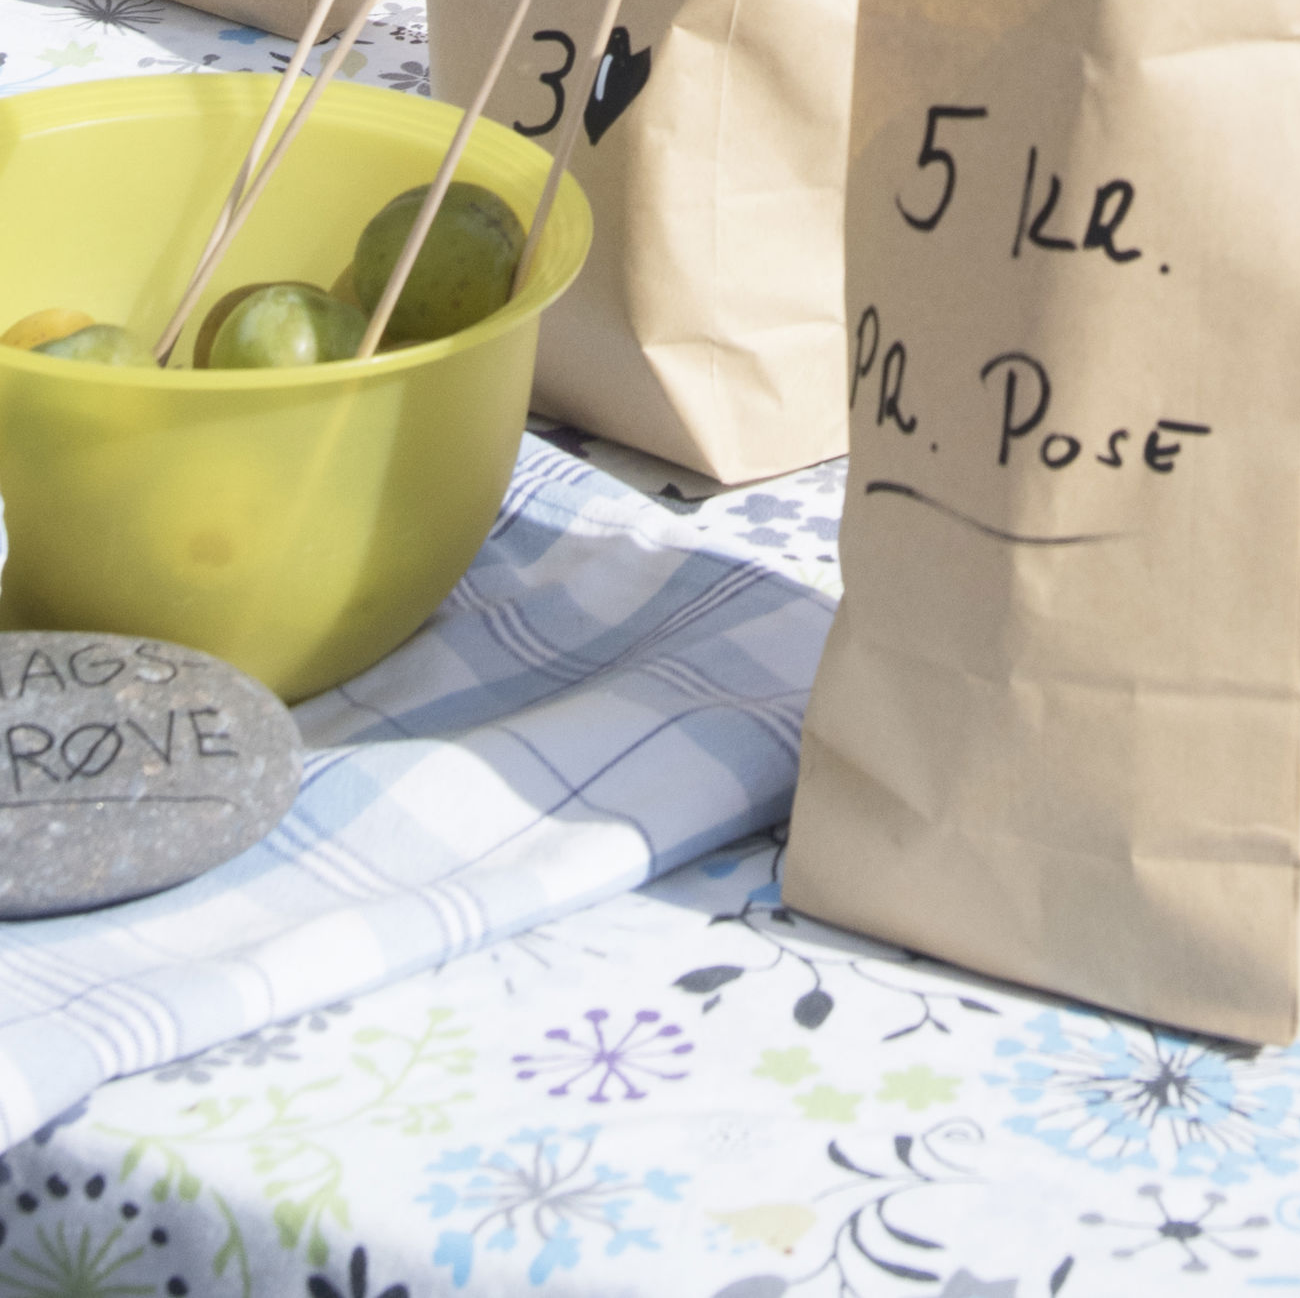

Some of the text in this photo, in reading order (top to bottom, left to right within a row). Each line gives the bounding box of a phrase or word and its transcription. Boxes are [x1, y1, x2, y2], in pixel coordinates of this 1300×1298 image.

[896, 106, 987, 231] 5
[0, 643, 209, 698] AGS-
[0, 707, 240, 793] RØVE
